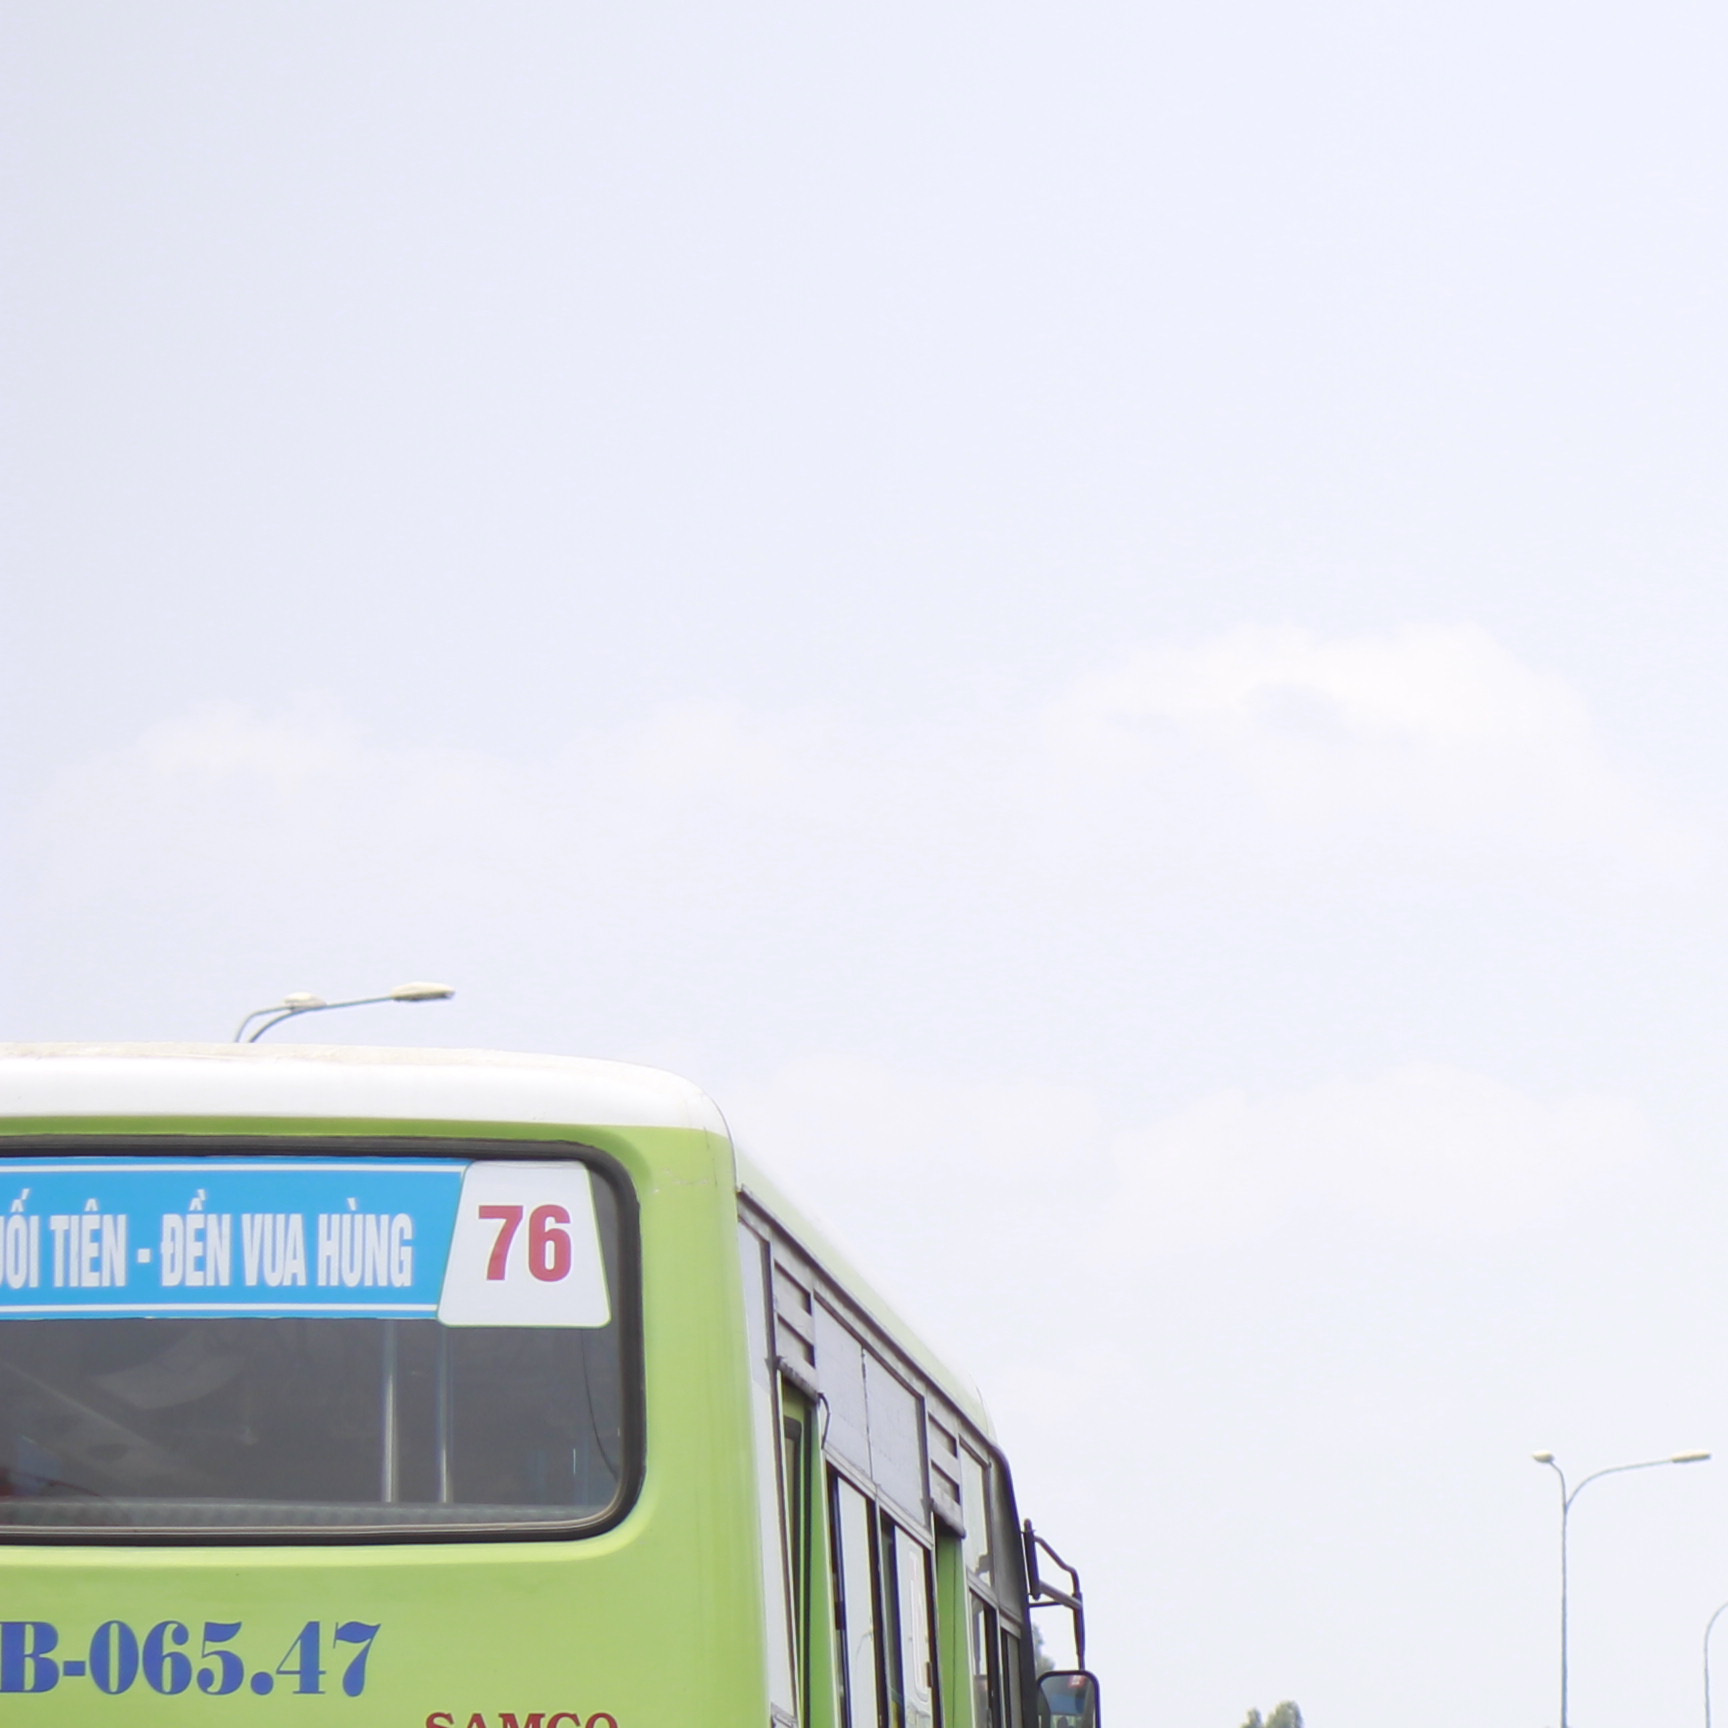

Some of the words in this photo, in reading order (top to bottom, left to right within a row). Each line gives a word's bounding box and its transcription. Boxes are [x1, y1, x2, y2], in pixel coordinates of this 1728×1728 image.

[0, 1188, 40, 1289] ỐI
[50, 1198, 127, 1288] TIÊN
[161, 1189, 230, 1287] ĐỀN
[242, 1213, 302, 1287] VUA
[317, 1198, 413, 1288] HÙNG
[478, 1203, 572, 1283] 76
[0, 1619, 381, 1698] B-065.47
